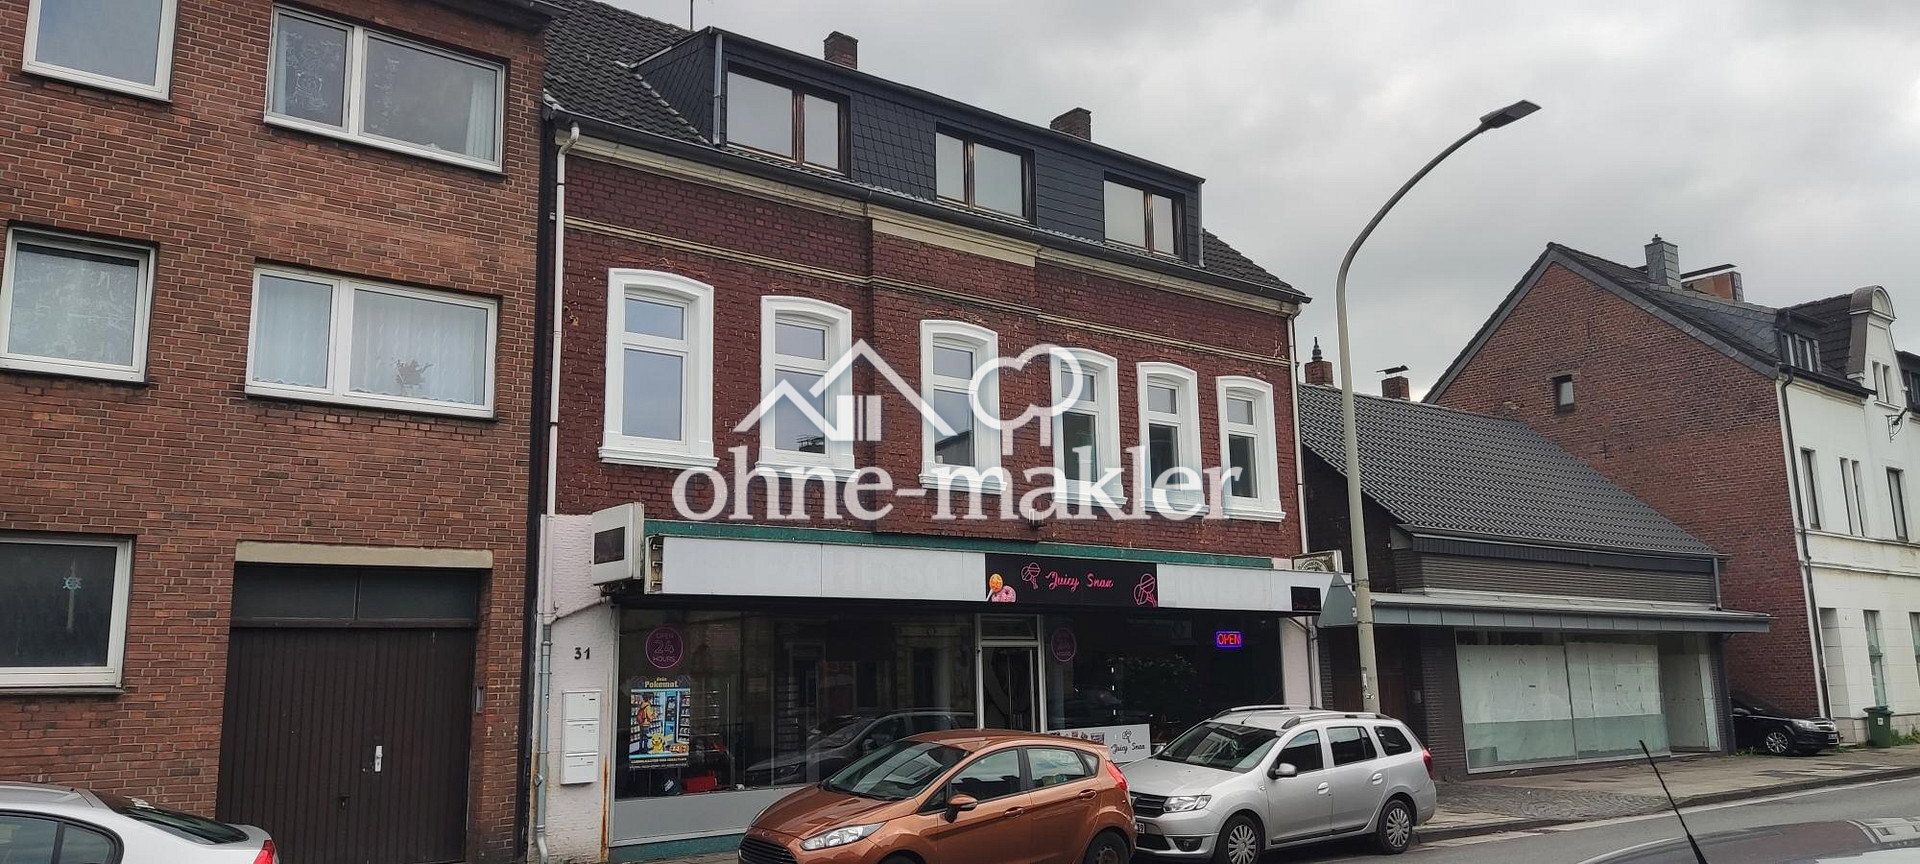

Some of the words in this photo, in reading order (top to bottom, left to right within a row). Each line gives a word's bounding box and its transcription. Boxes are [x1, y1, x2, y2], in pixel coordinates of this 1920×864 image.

[1045, 571, 1080, 593] Juicy
[1218, 633, 1241, 645] OPEN
[574, 647, 591, 660] 31
[653, 640, 675, 654] 24
[1111, 744, 1128, 754] Juicy
